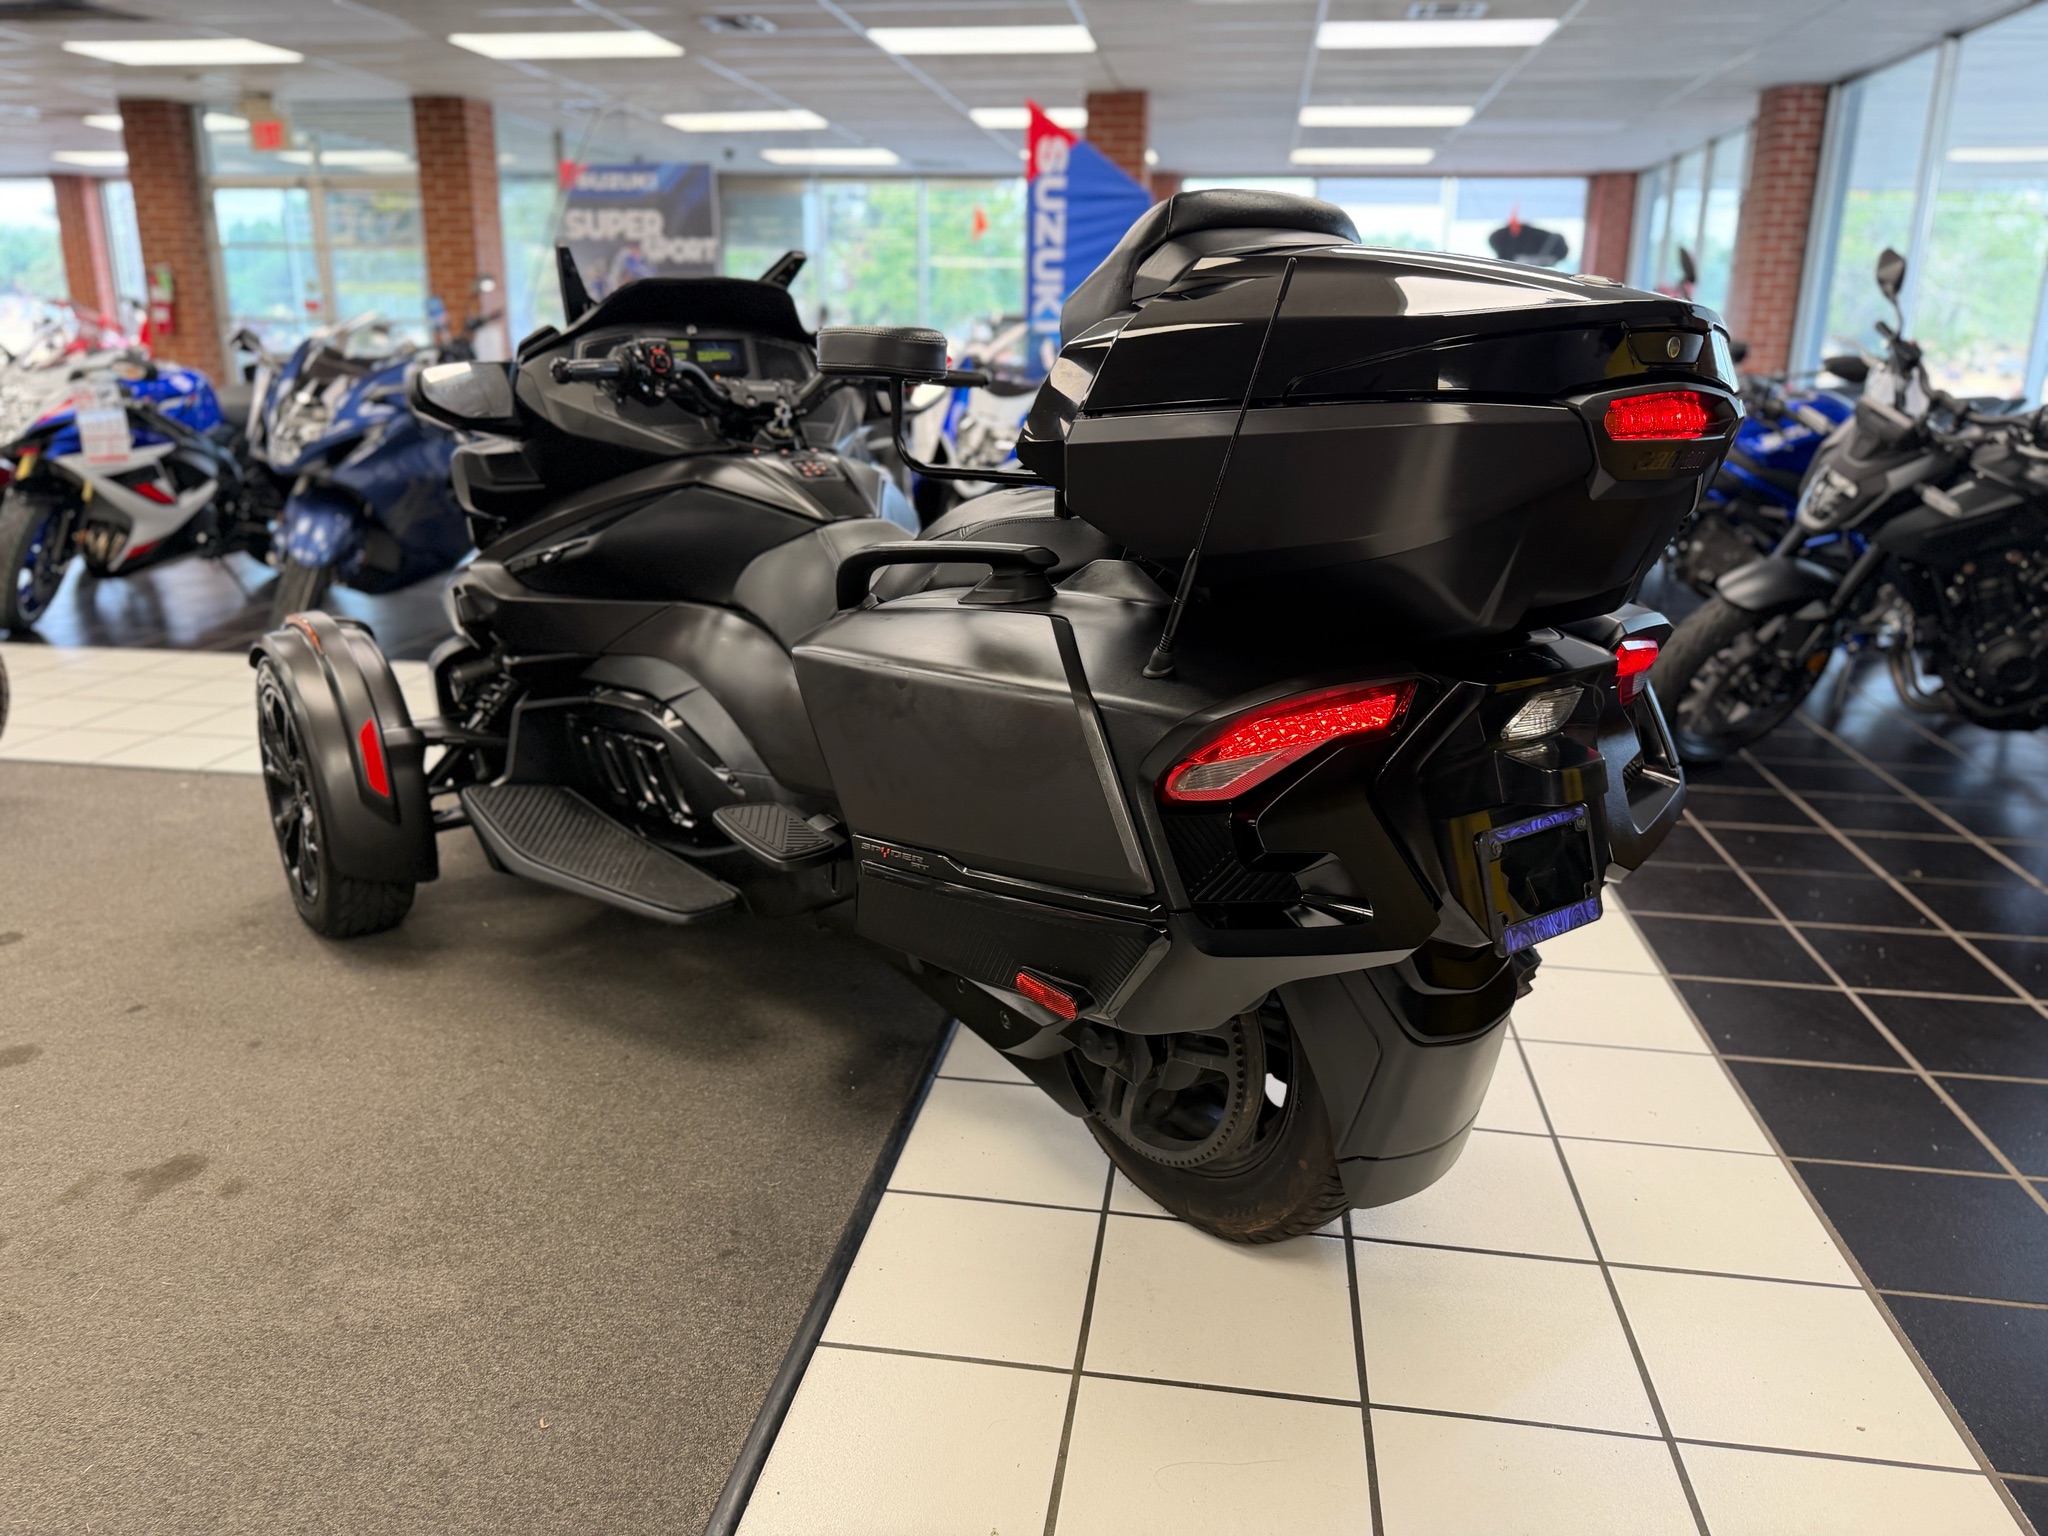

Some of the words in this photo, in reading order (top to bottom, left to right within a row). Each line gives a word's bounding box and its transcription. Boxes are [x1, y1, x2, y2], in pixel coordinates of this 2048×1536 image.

[576, 171, 659, 192] SUZUKI
[565, 208, 664, 241] SUPER
[1031, 135, 1069, 334] SUZUKI
[641, 235, 718, 264] SPORT
[860, 842, 924, 863] SPYDER
